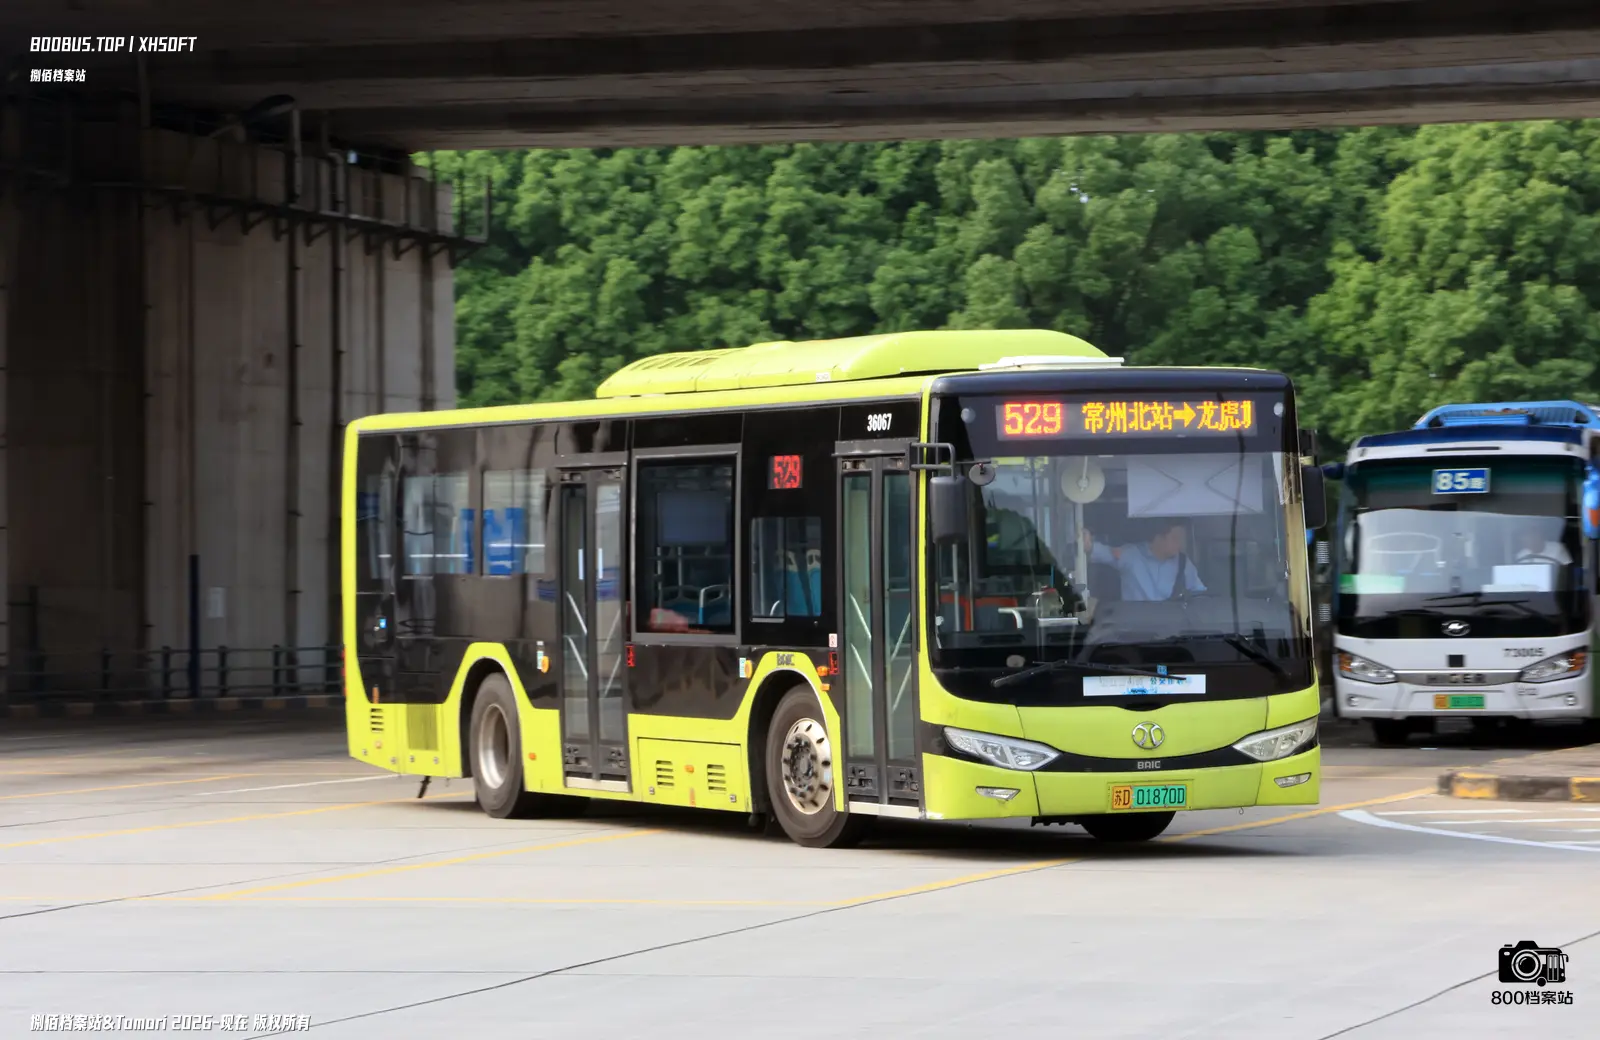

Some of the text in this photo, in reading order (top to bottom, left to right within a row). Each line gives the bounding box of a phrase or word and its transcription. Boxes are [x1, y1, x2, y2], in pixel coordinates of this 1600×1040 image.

[867, 413, 892, 432] 36067
[1004, 402, 1060, 435] 529
[1082, 401, 1173, 433] 常州北站
[773, 455, 800, 488] 529
[1137, 760, 1161, 770] BAIC
[1114, 787, 1185, 806] 苏D 01870D
